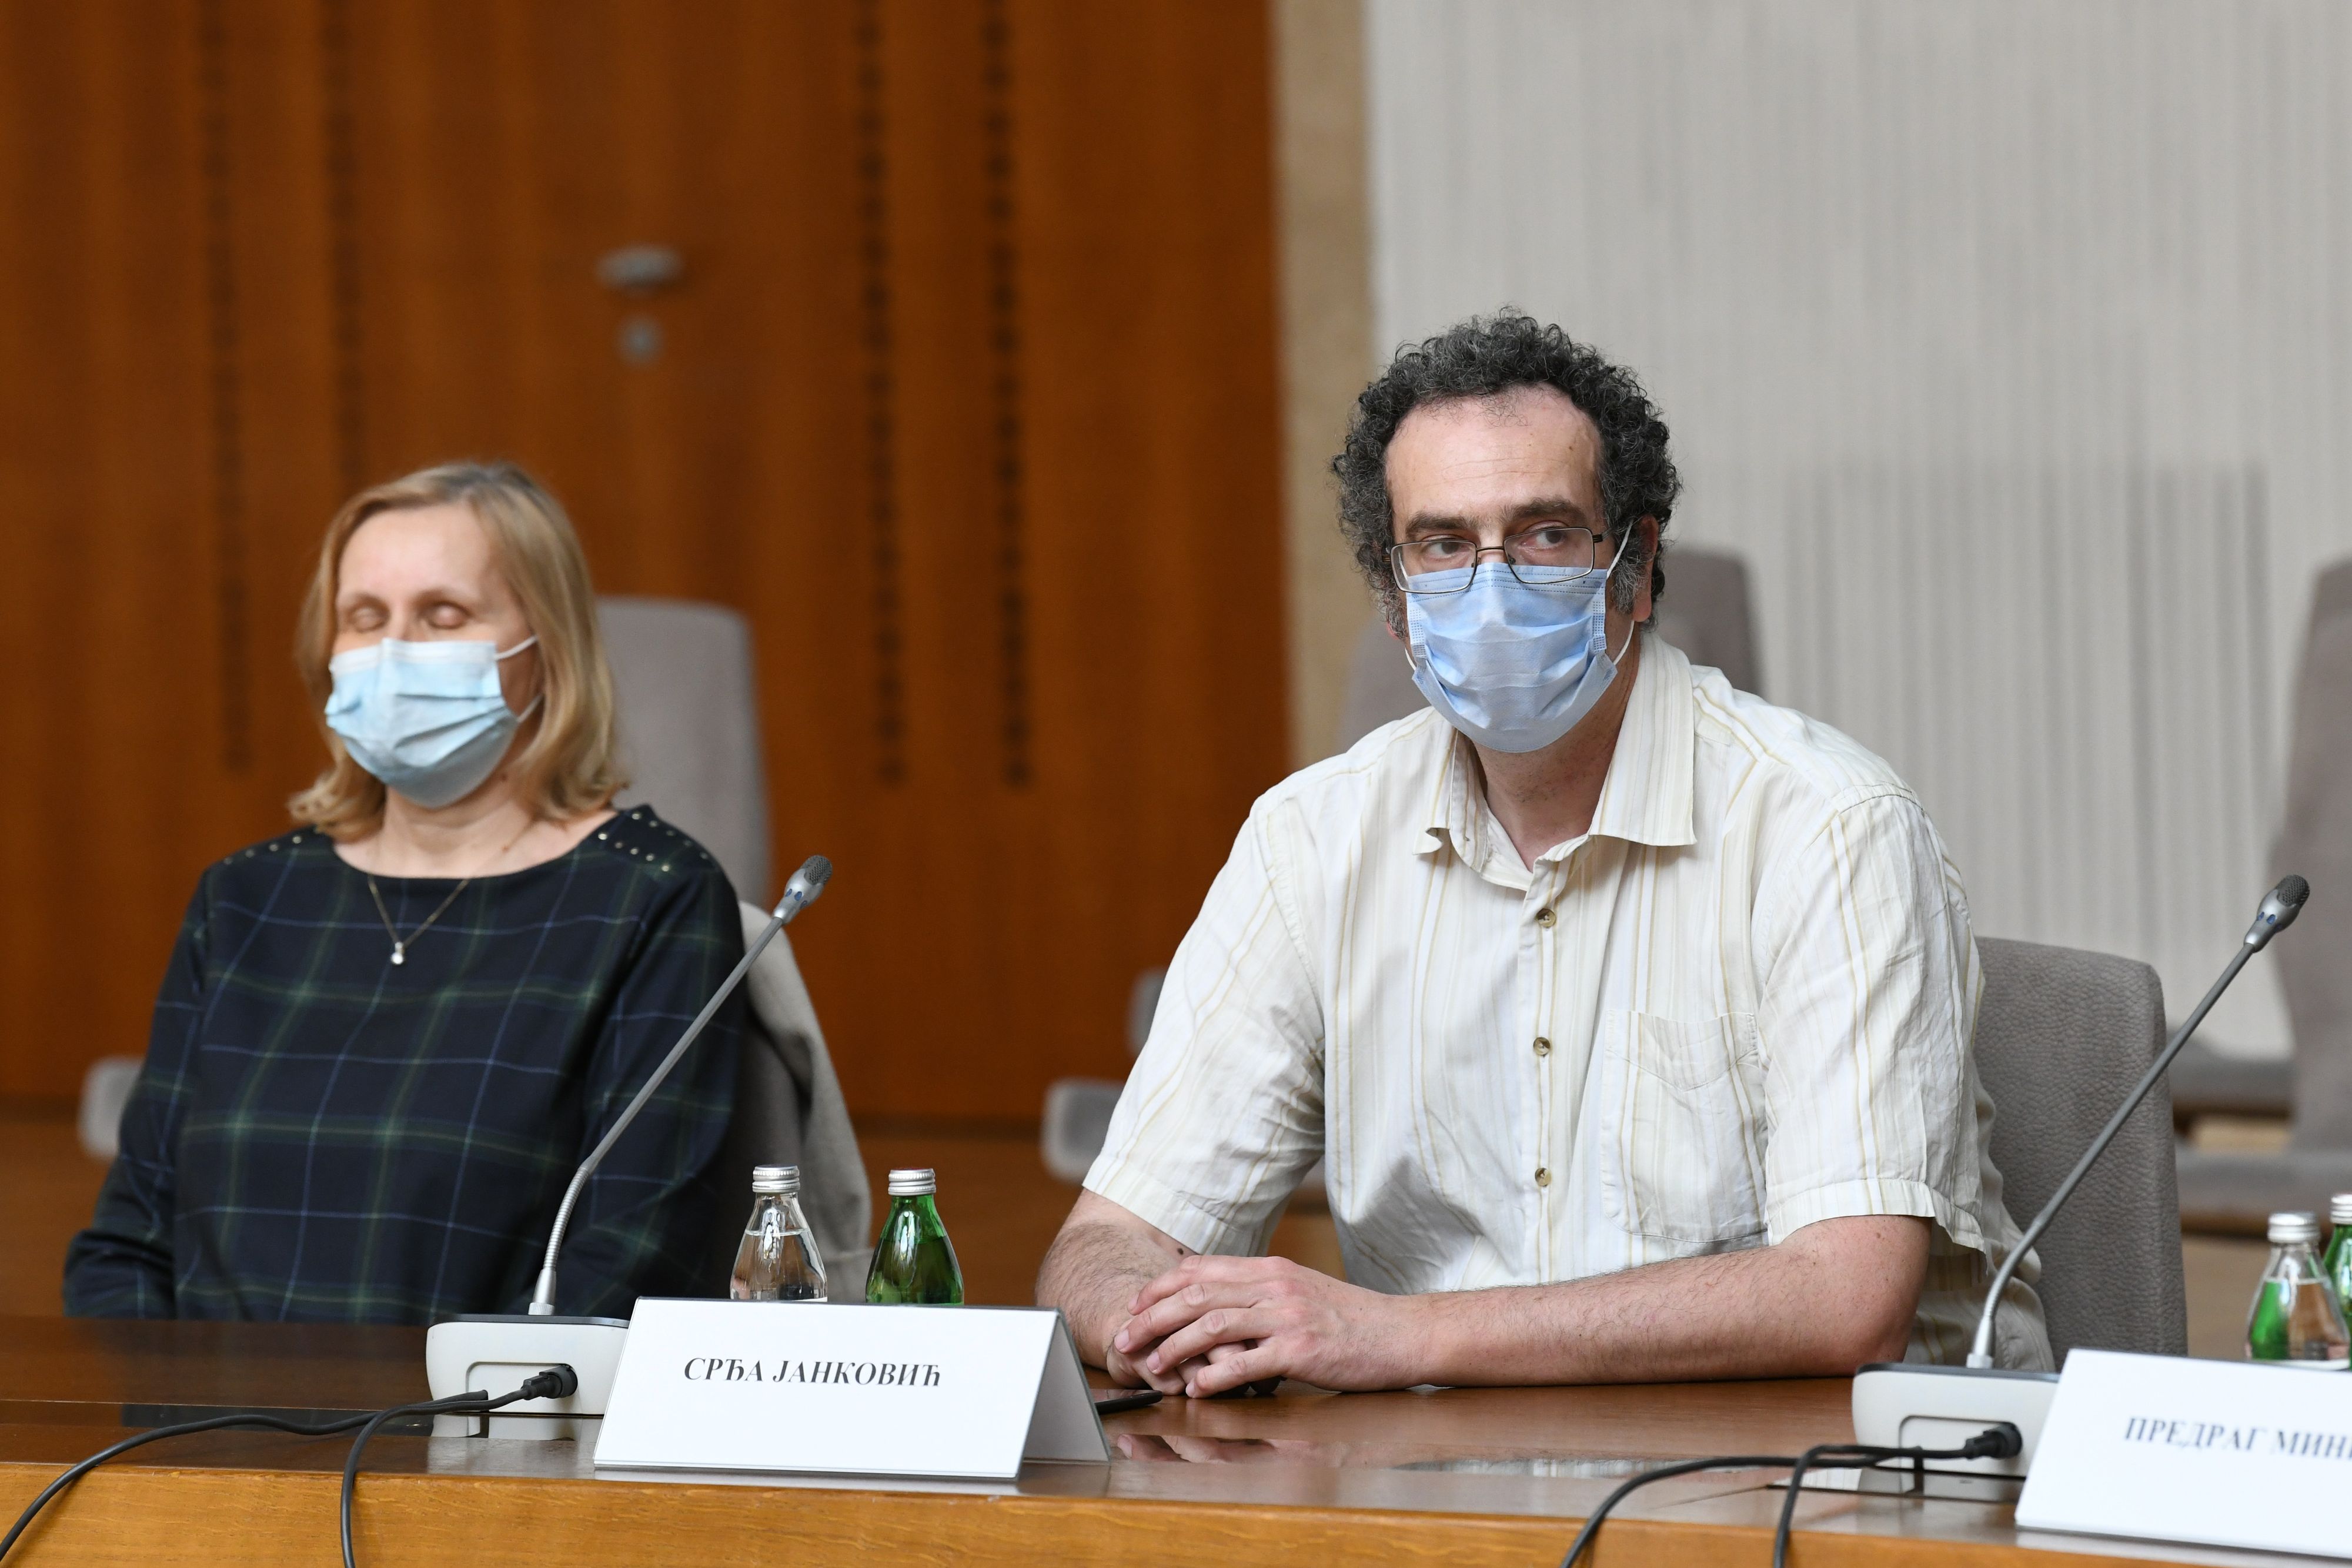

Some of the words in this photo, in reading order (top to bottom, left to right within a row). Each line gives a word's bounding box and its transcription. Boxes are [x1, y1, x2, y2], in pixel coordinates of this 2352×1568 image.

[684, 1357, 763, 1382] СРЂА
[772, 1360, 941, 1388] ЈАНКОВИЋ
[2124, 1417, 2269, 1450] ПРЕДРАГ
[2271, 1429, 2352, 1459] МИН
